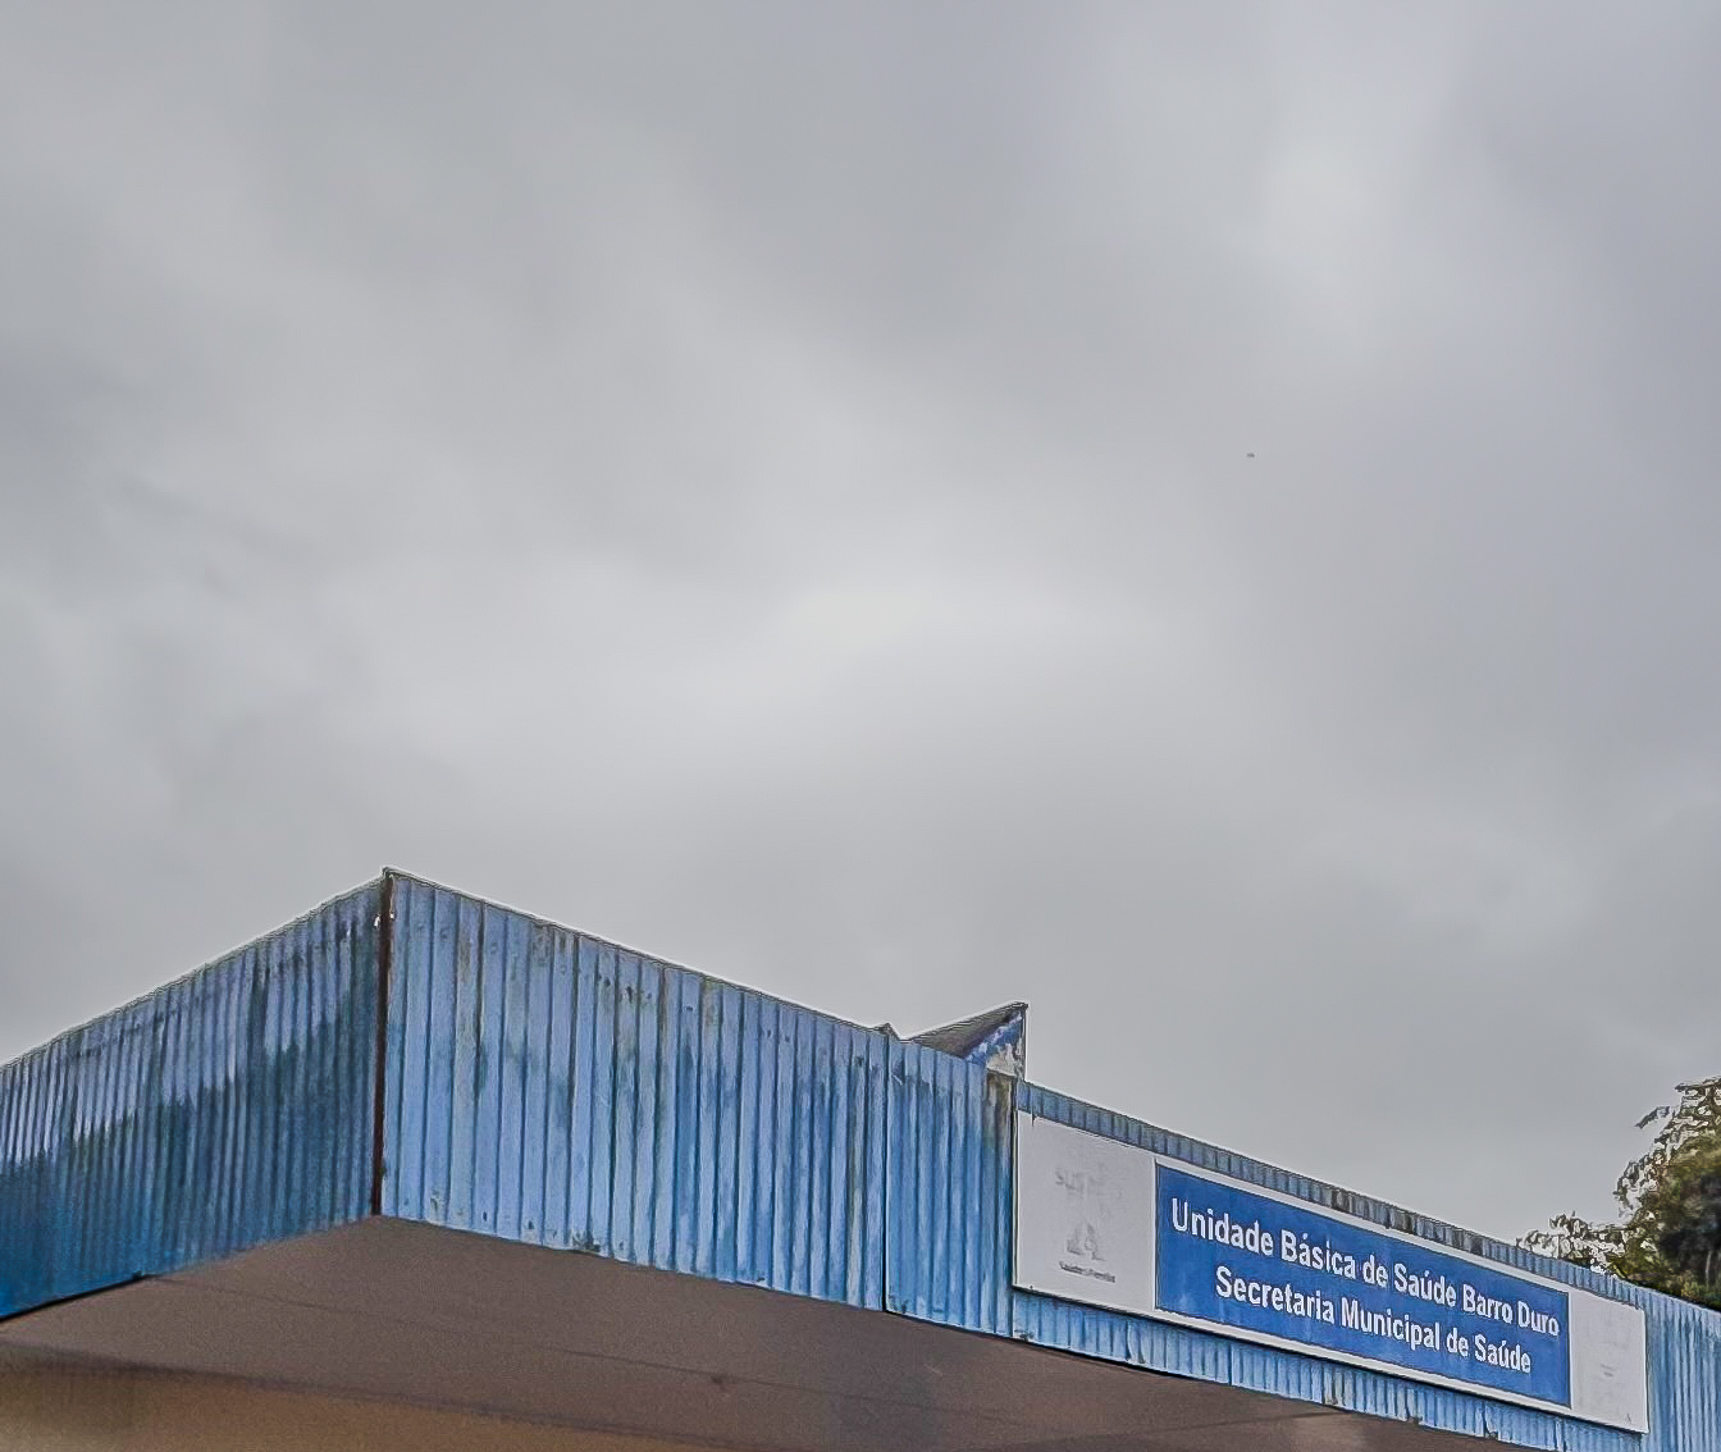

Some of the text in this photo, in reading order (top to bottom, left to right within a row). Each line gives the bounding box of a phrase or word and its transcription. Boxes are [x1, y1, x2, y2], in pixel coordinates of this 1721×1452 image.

[1172, 1198, 1560, 1337] Unidade Básica de Saúde Barro Duro
[1216, 1265, 1532, 1374] Secretaria Municipal de Saúde
